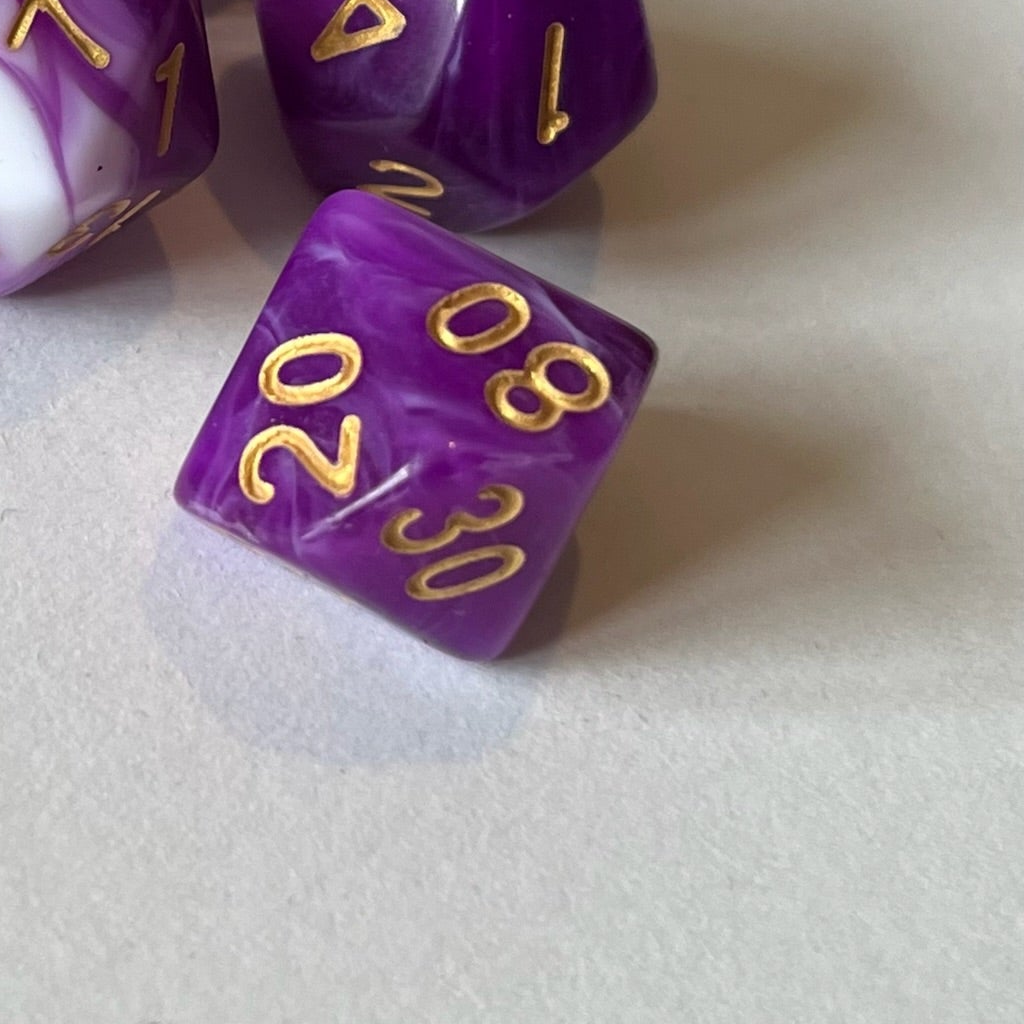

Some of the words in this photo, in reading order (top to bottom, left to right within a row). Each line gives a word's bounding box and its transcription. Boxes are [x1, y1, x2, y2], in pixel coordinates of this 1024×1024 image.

[157, 42, 185, 156] 1
[536, 22, 570, 144] 1
[239, 332, 363, 505] 20
[426, 282, 611, 433] 80
[381, 484, 526, 601] 30
